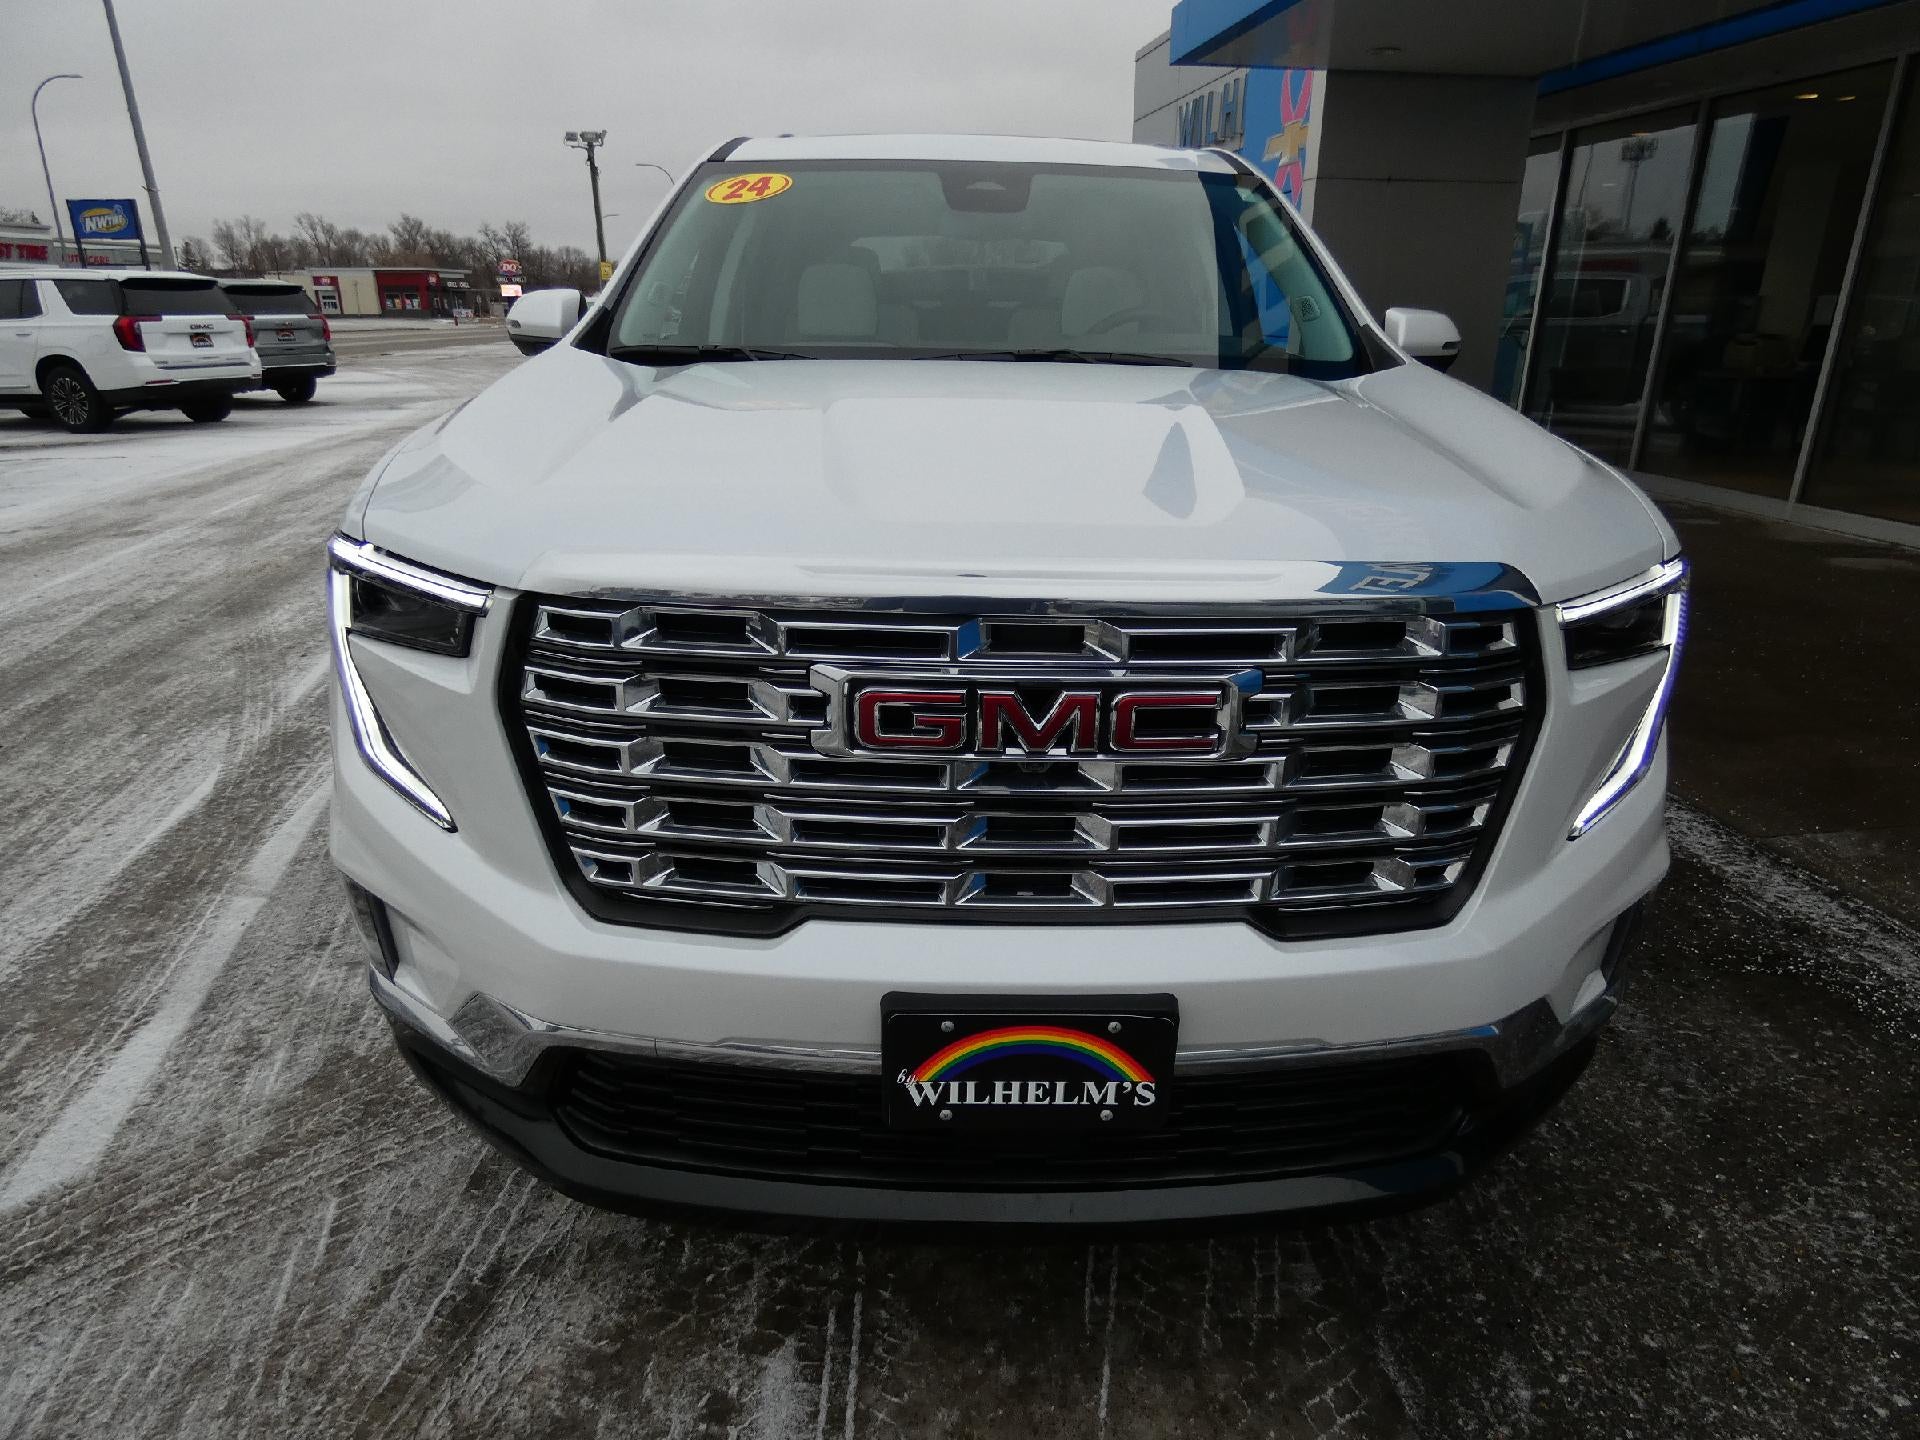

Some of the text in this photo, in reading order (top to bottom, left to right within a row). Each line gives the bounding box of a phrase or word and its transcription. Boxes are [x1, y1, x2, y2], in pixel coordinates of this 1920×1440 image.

[722, 176, 773, 201] 24
[502, 263, 517, 272] DQ
[854, 688, 1223, 752] GMC
[907, 1080, 1157, 1107] WILHELM'S
